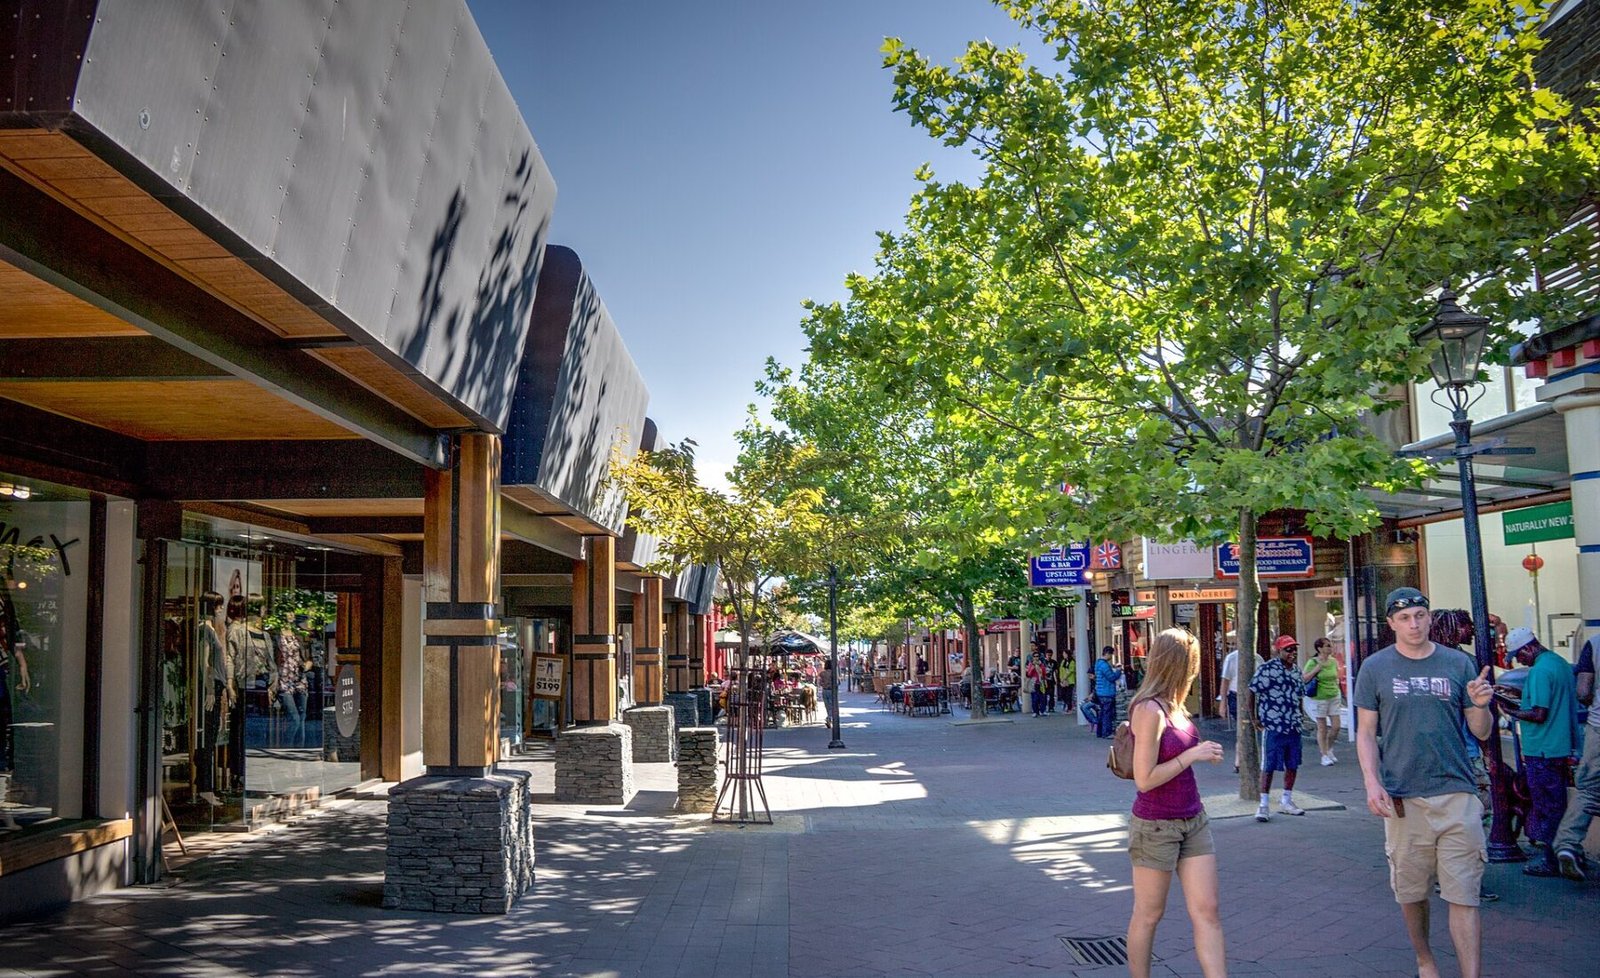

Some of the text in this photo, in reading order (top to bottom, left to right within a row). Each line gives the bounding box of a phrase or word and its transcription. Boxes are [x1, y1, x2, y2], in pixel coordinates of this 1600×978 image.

[1505, 519, 1547, 533] NATURALLY
[1549, 516, 1568, 527] NEW
[1273, 558, 1306, 566] RESTAURANT
[536, 682, 560, 691] $199
